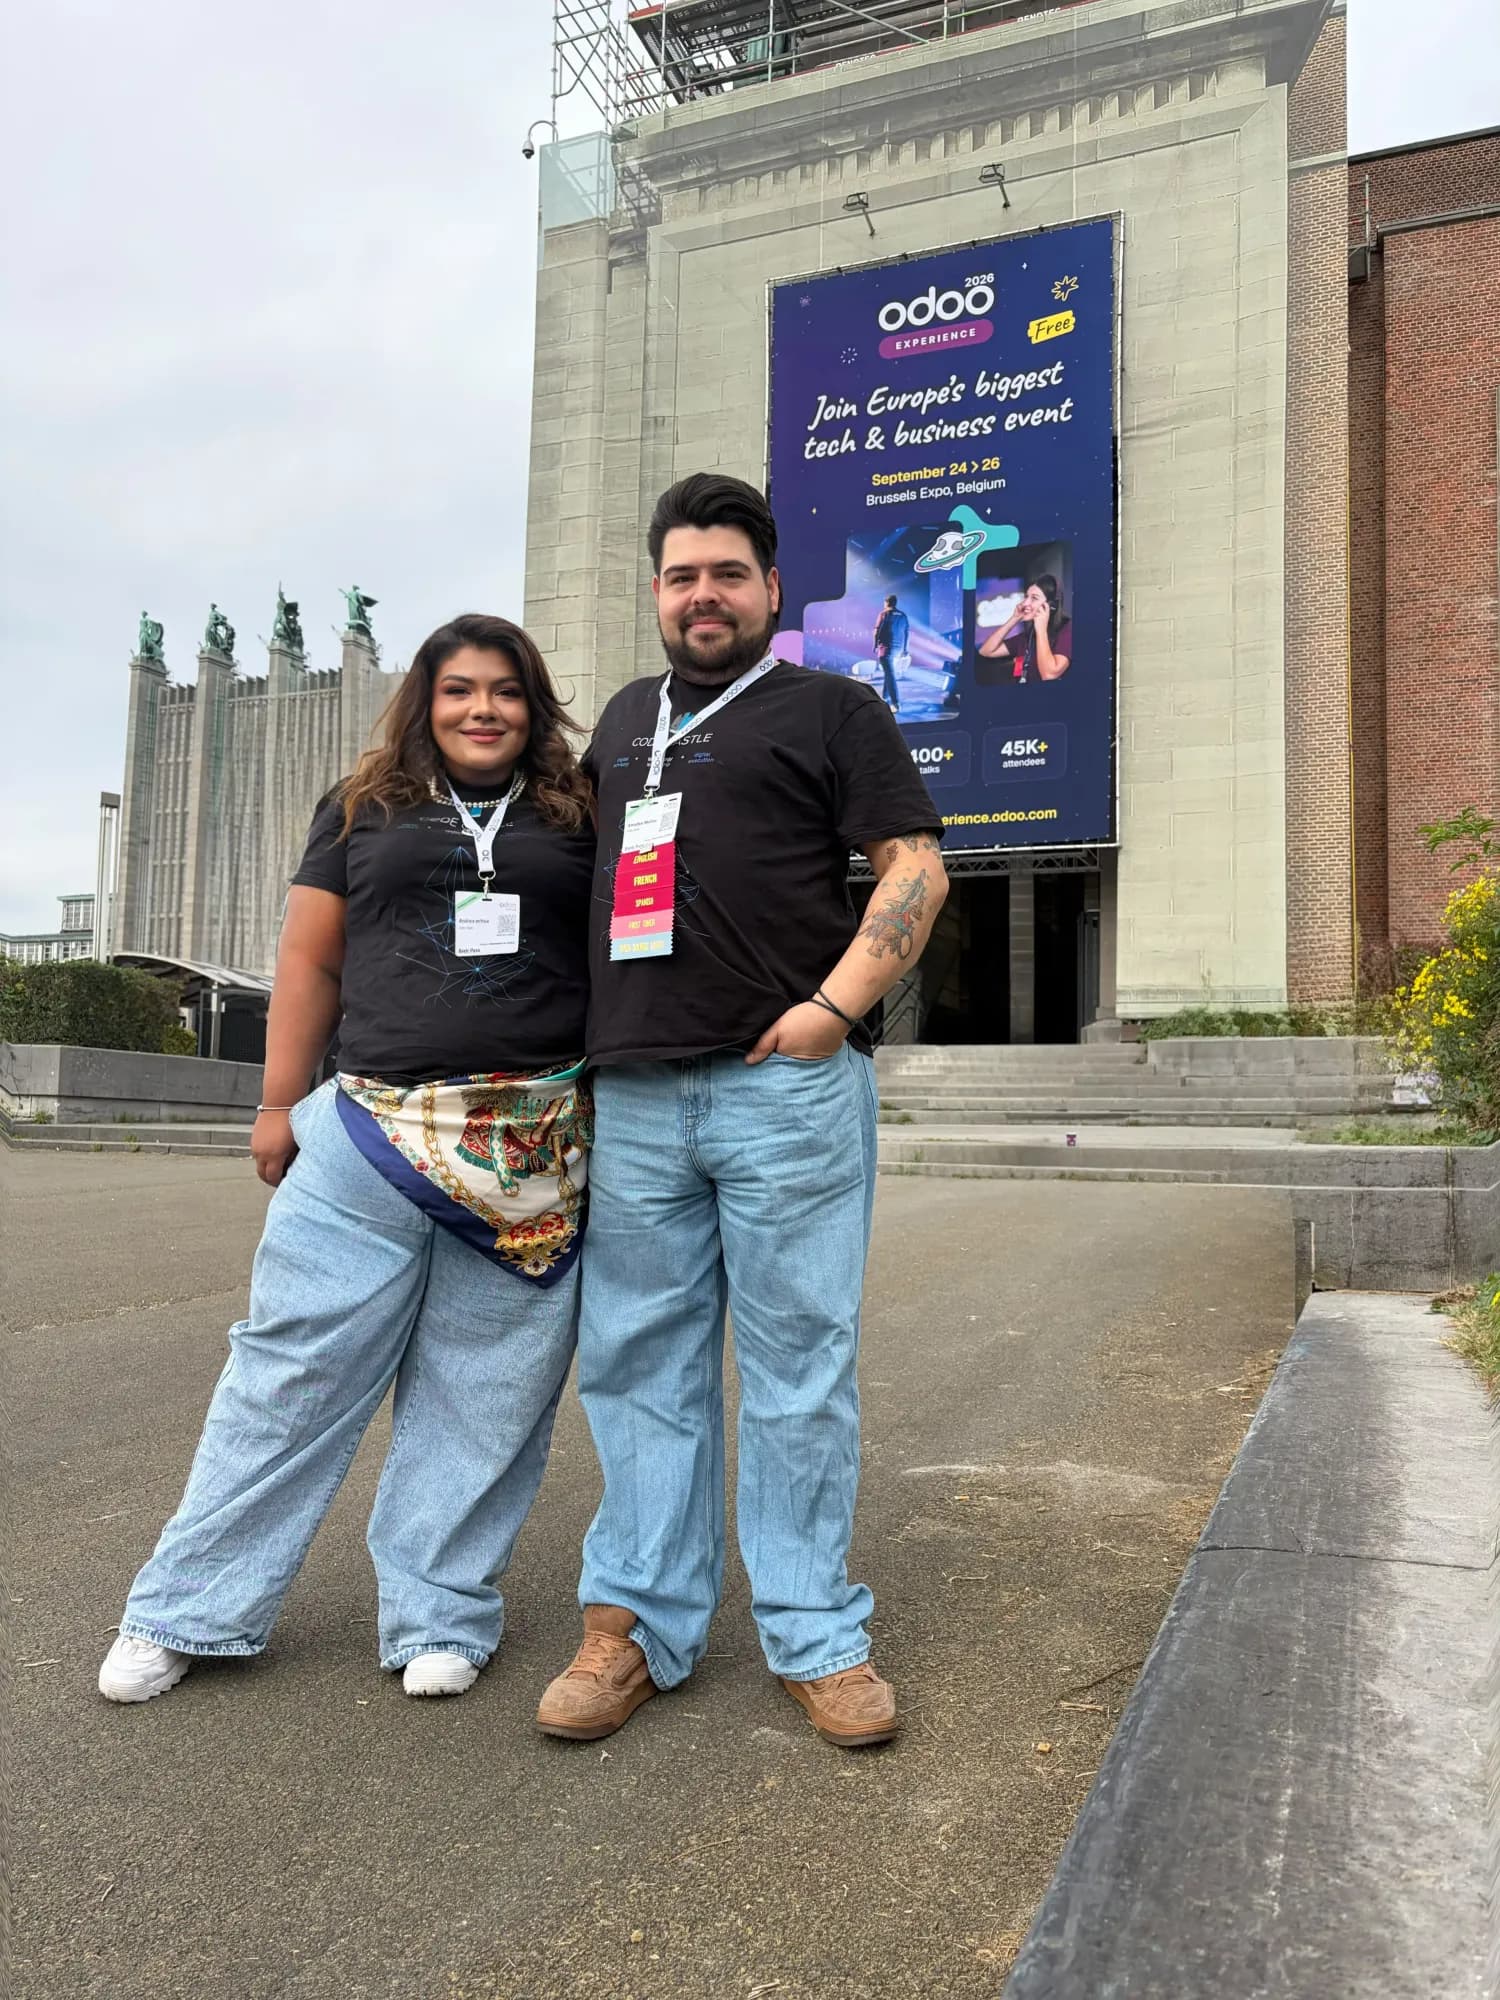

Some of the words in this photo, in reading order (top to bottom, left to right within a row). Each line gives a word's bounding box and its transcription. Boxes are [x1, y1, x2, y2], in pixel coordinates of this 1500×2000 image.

[965, 273, 994, 287] 2026
[878, 285, 995, 331] odoo
[895, 328, 977, 350] EXPERIENCE
[1034, 317, 1071, 340] Free
[808, 396, 857, 431] Join
[867, 375, 966, 416] Europe's
[975, 360, 1064, 401] biggest
[804, 430, 856, 459] tech
[865, 427, 886, 450] &
[894, 413, 996, 447] business
[1004, 398, 1073, 431] event
[872, 466, 946, 487] September
[949, 461, 968, 476] 24
[981, 457, 1000, 471] 26
[866, 489, 917, 506] Brussels
[920, 486, 954, 500] Expo,
[956, 478, 1006, 495] Belgium
[632, 737, 655, 748] COD
[1001, 739, 1048, 756] 45K+
[1003, 758, 1046, 768] attendees
[633, 873, 658, 887] FRENCH
